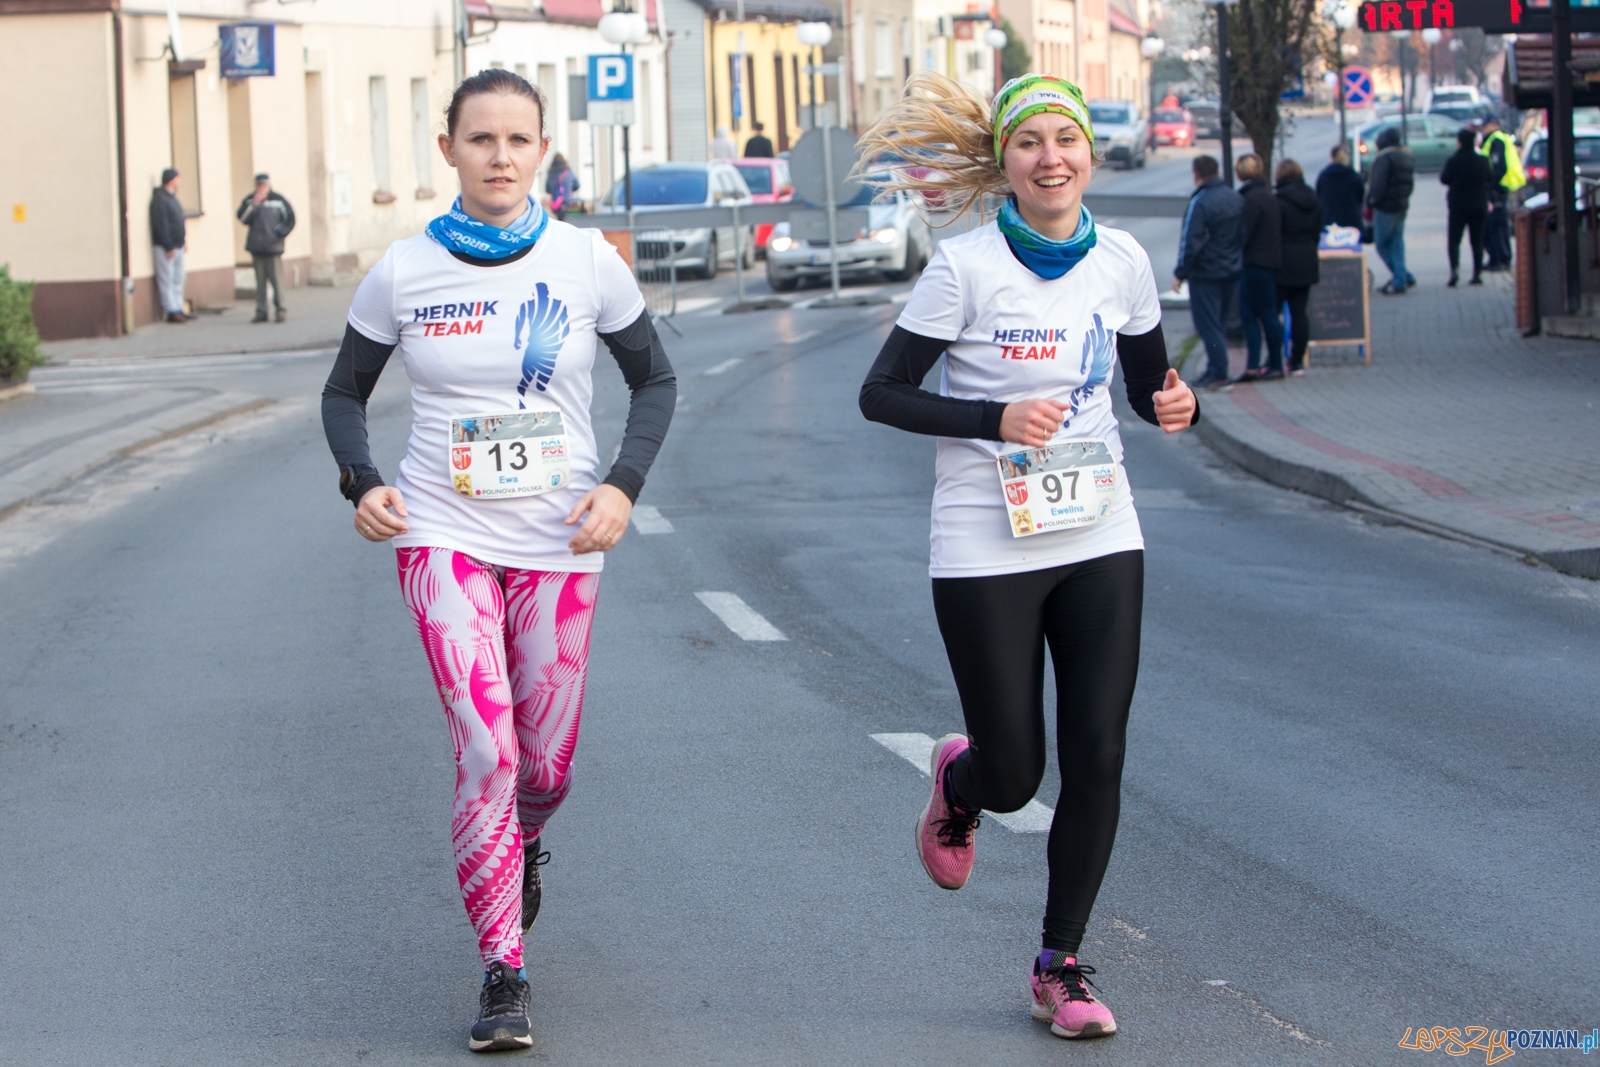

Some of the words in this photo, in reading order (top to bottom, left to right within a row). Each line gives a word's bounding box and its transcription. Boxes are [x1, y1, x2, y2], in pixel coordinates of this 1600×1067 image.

[597, 57, 627, 97] P
[413, 300, 499, 322] HERNIK
[423, 320, 484, 337] TEAM
[992, 328, 1068, 343] HERNIK
[1000, 345, 1057, 360] TEAM
[488, 441, 528, 472] 13
[499, 475, 518, 484] Ewa
[1042, 470, 1080, 503] 97
[482, 487, 516, 495] POLINOVA
[517, 485, 542, 493] POLSKA
[1051, 505, 1085, 516] Ewelina
[1043, 517, 1077, 528] POLINOVA
